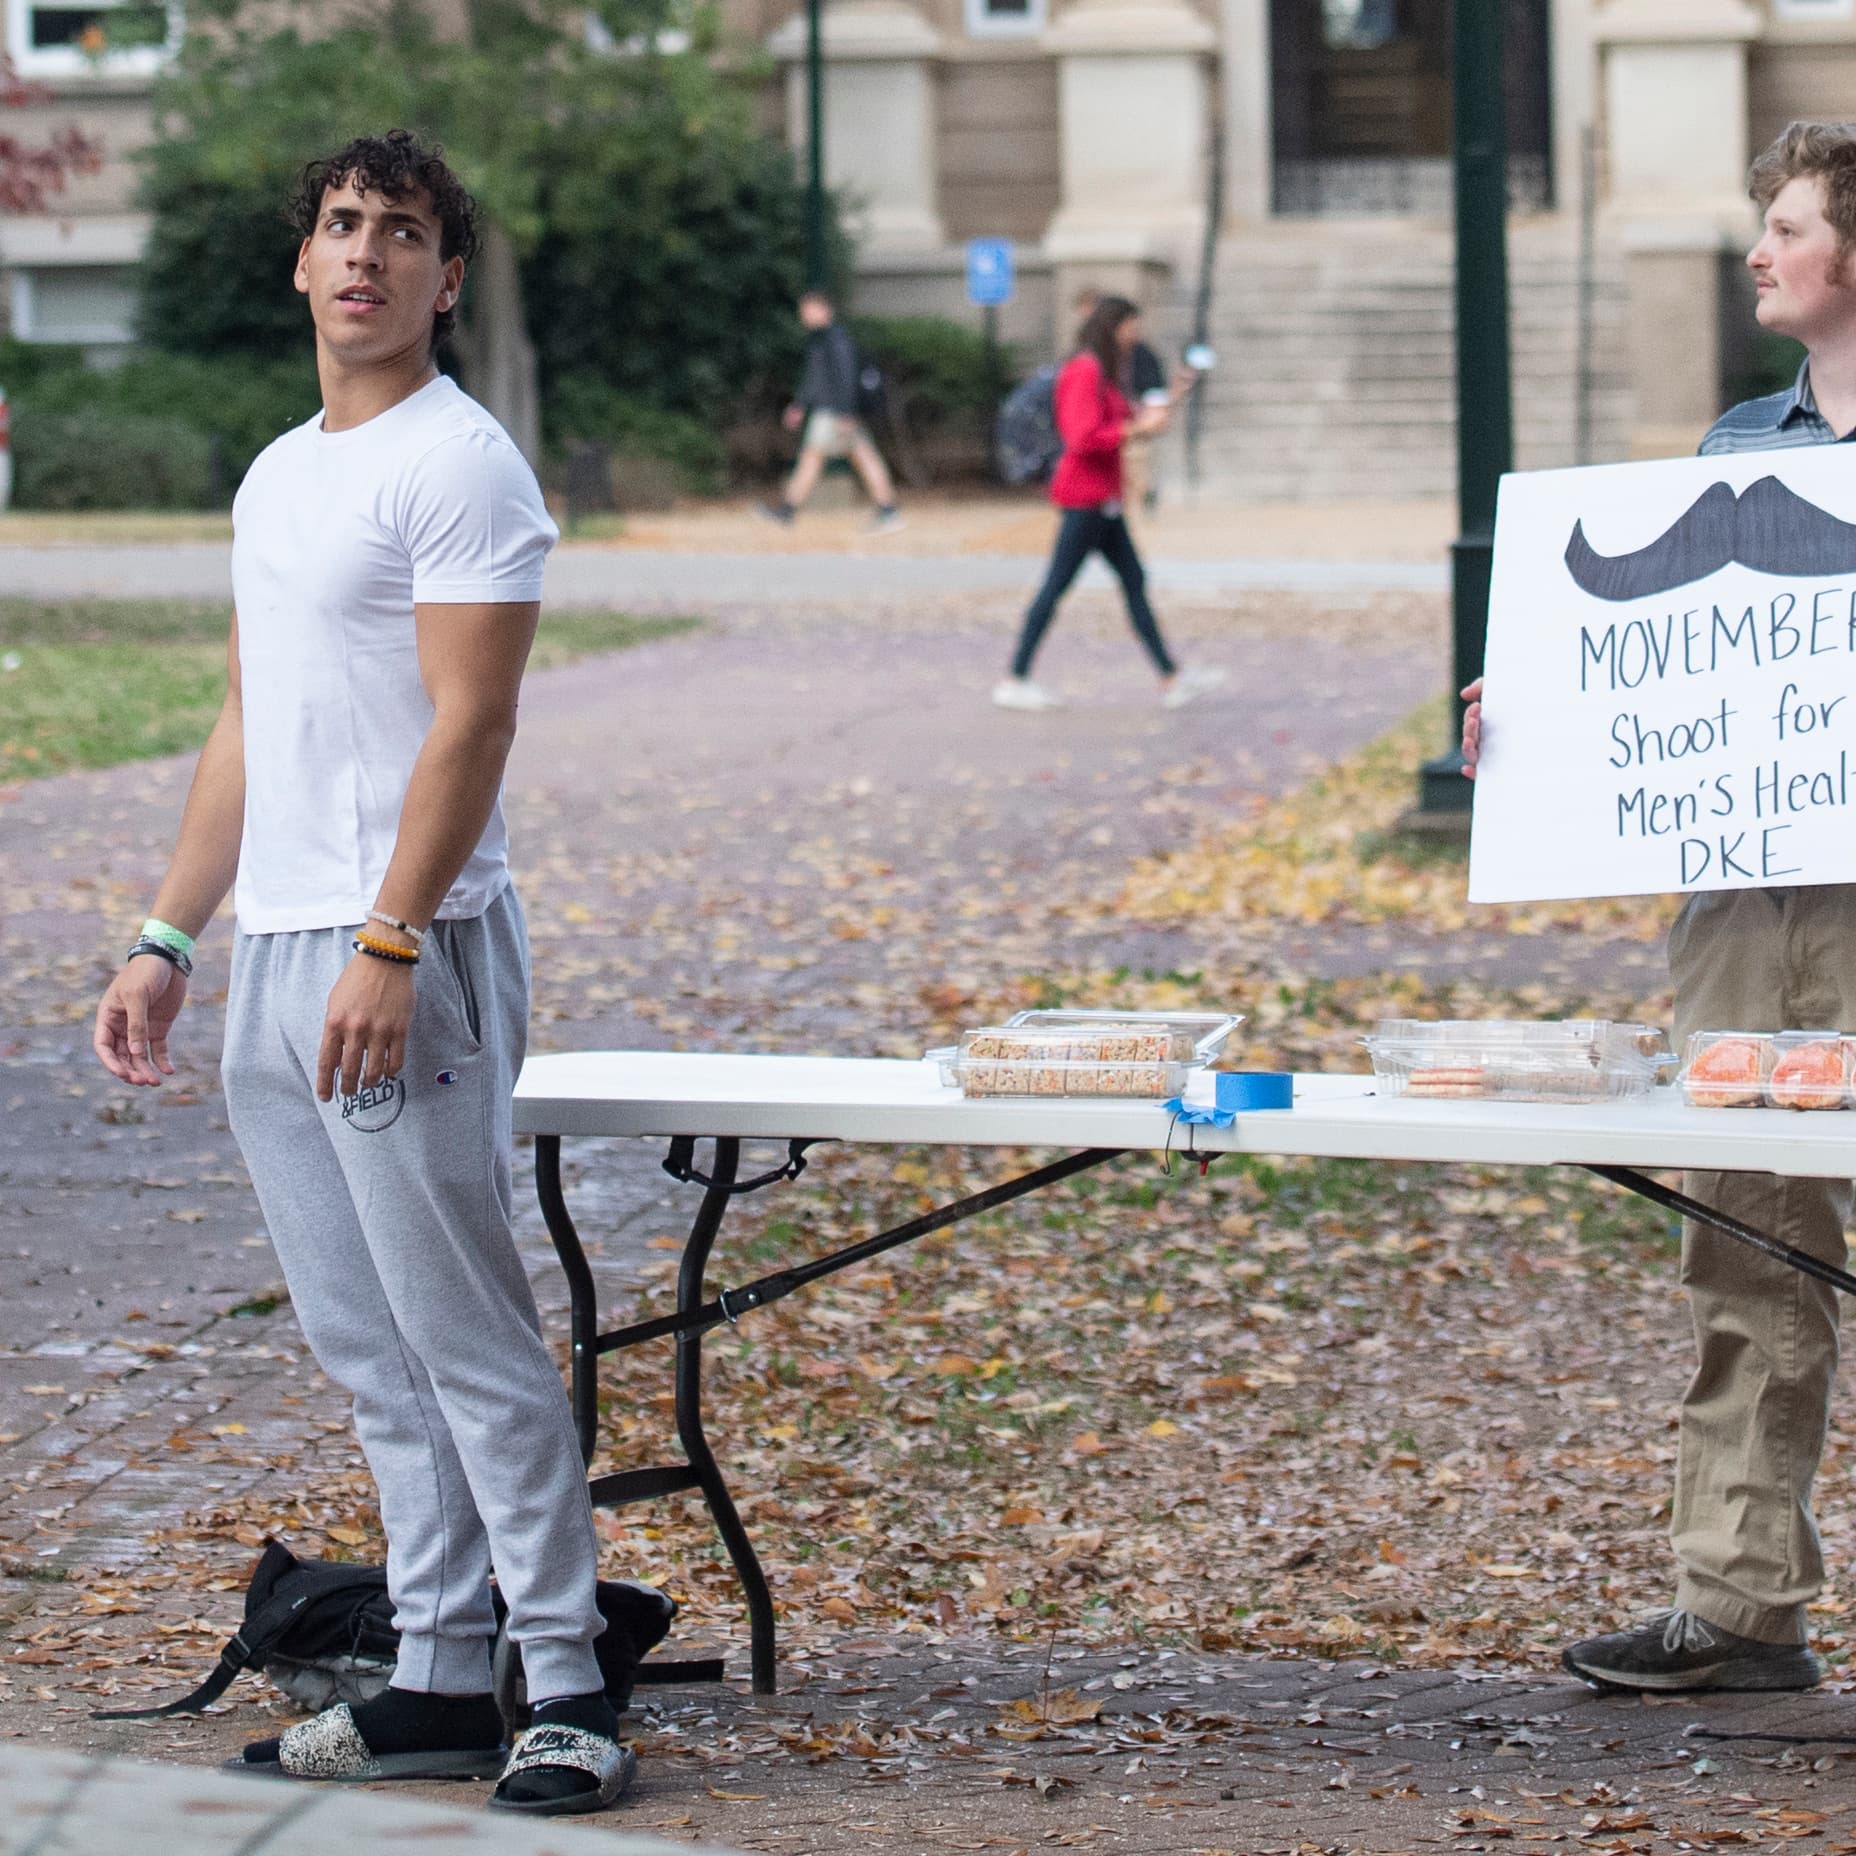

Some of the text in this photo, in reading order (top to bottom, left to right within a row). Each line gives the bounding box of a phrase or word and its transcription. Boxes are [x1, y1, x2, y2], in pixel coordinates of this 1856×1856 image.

[1609, 683, 1848, 769] Shoot for
[1617, 773, 1735, 837] Men's
[1681, 825, 1803, 885] DKE
